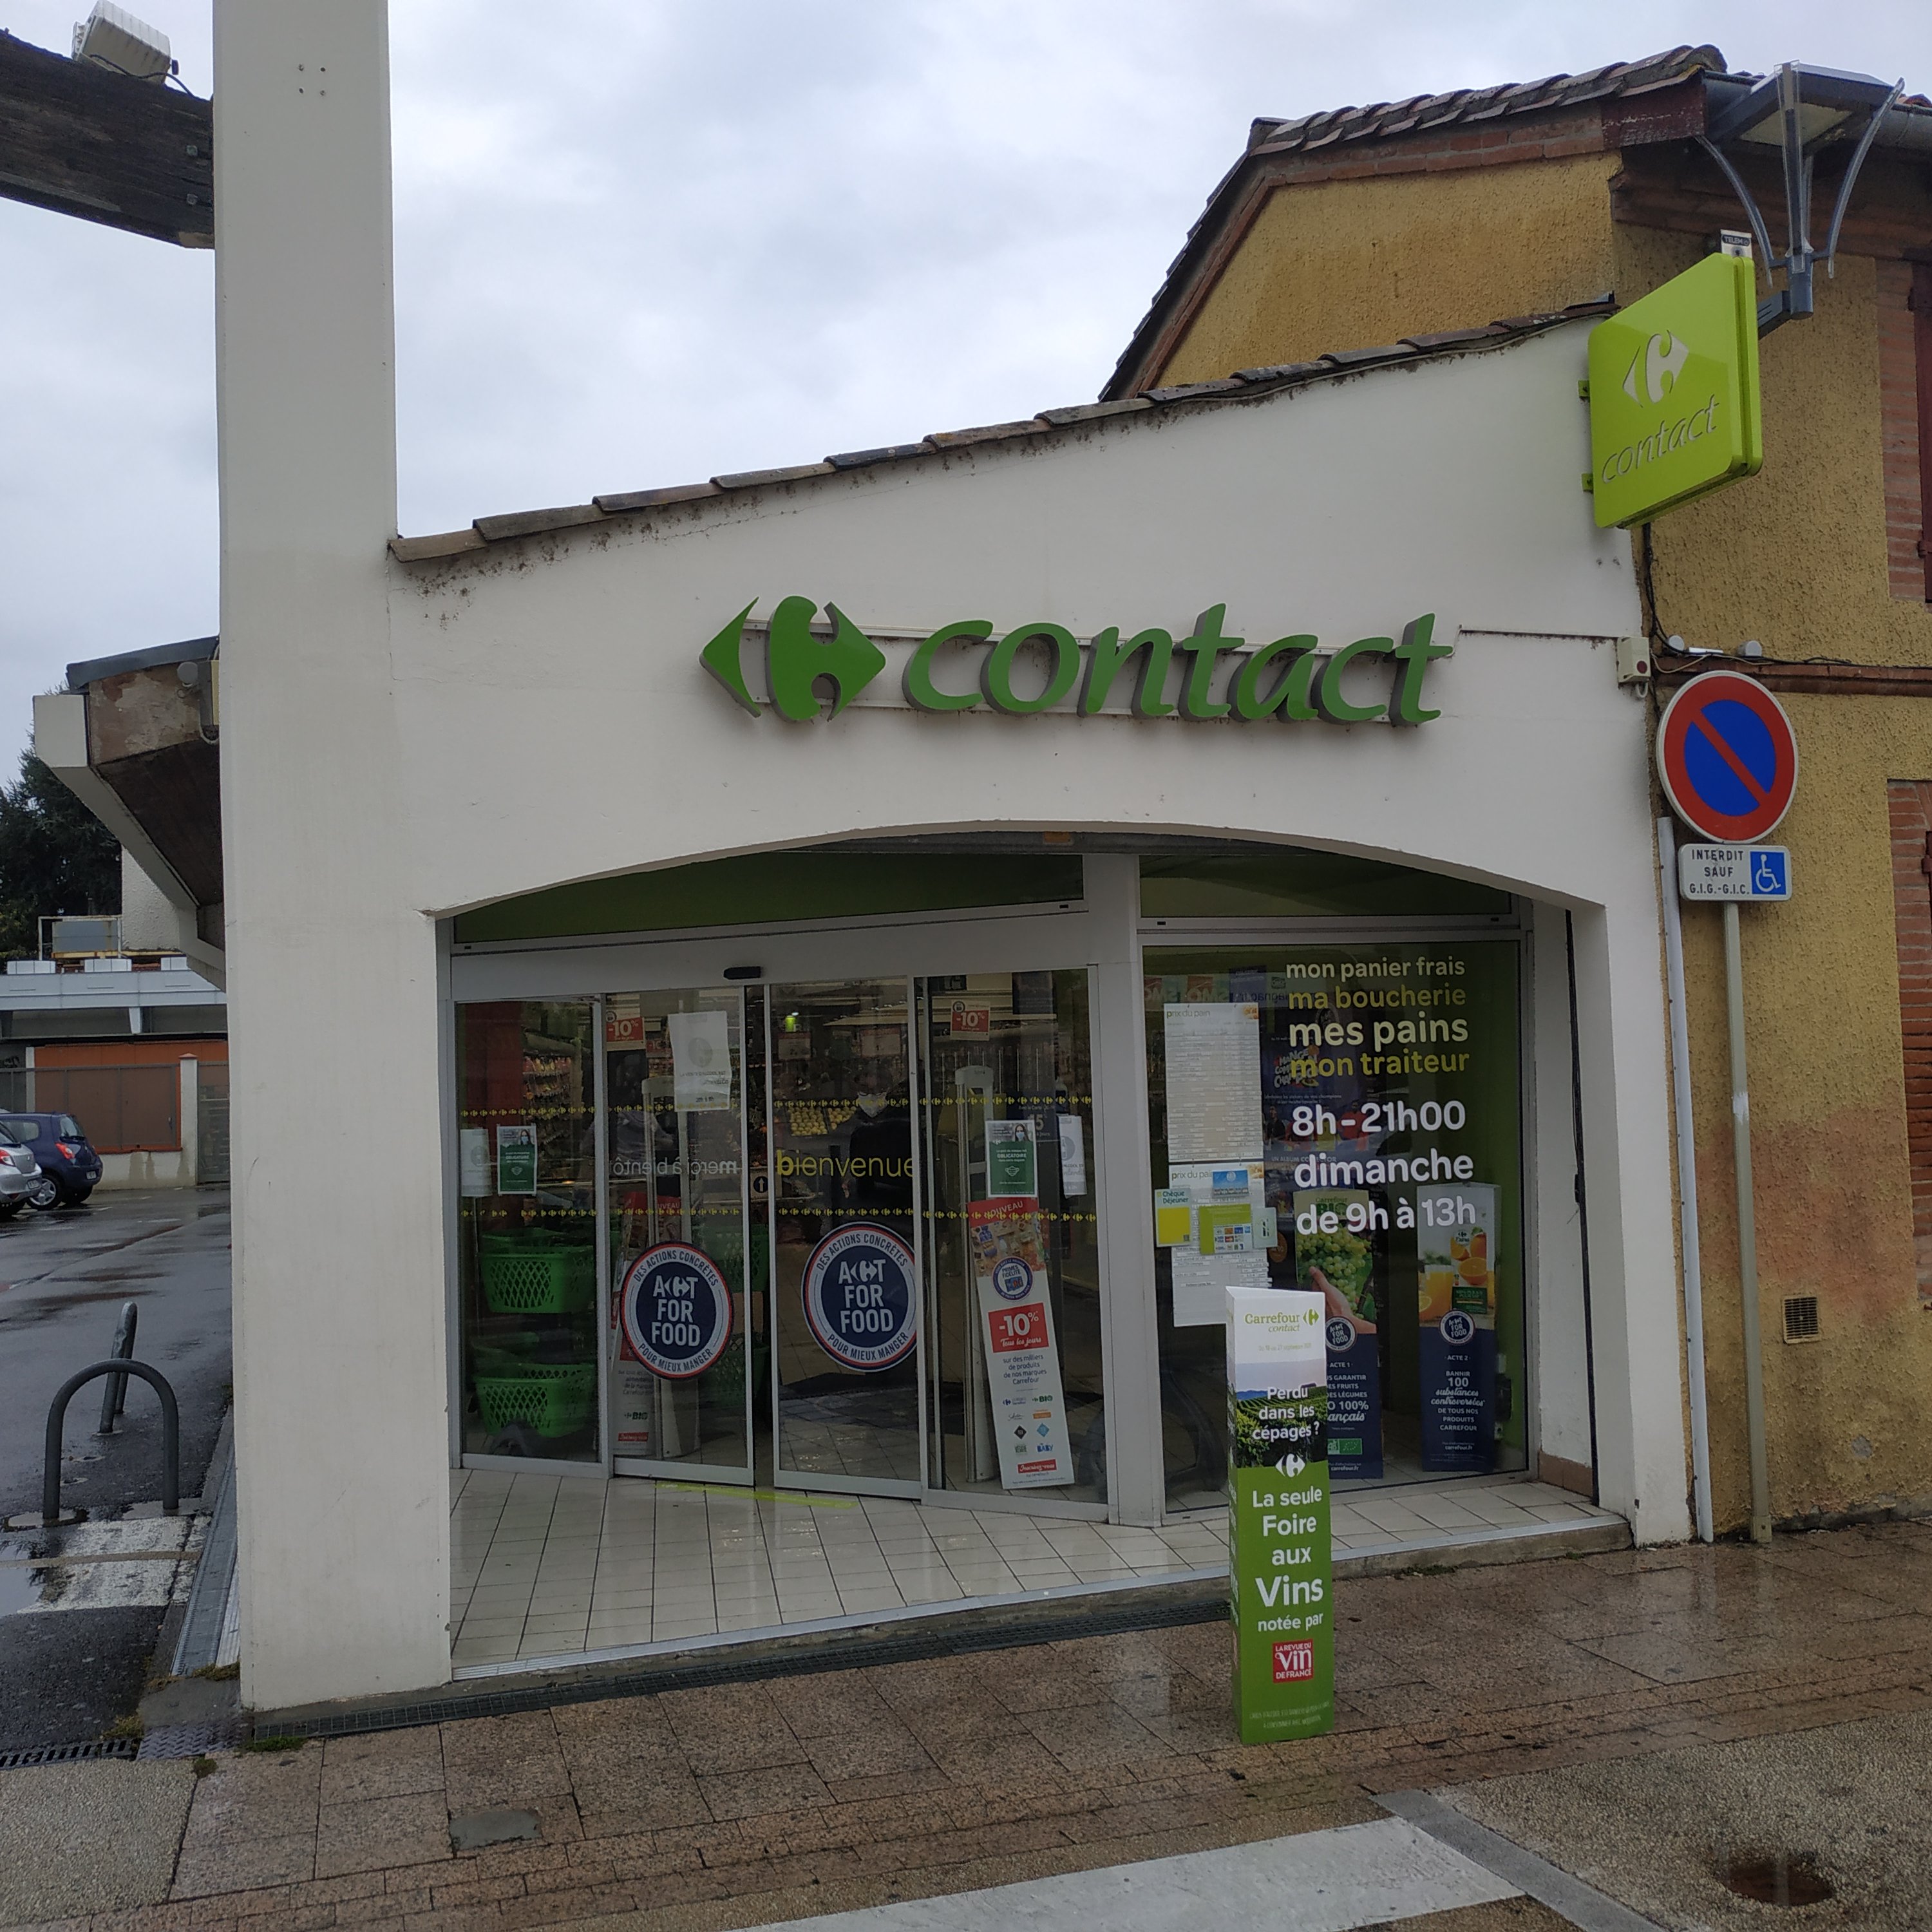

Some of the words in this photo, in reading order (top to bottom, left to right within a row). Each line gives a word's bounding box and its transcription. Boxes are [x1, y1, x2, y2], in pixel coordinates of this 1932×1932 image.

[1602, 393, 1720, 484] contact
[903, 603, 1453, 723] contact
[1692, 849, 1743, 860] INTERDIT
[1704, 867, 1733, 877] SAUF
[1286, 962, 1335, 979] mon
[1341, 957, 1411, 982] panier
[1416, 956, 1465, 976] frais
[1289, 992, 1329, 1010] ma
[1335, 983, 1466, 1009] boucherie
[1289, 1022, 1363, 1047] mes
[1374, 1012, 1469, 1052] pains
[1291, 1057, 1354, 1077] mon
[1360, 1049, 1470, 1076] traiteur
[776, 1148, 913, 1177] bienvenue
[1294, 1148, 1473, 1188] dimanche
[1171, 1171, 1186, 1181] prix
[1187, 1170, 1198, 1179] du
[1199, 1171, 1212, 1181] pai
[1162, 1197, 1189, 1205] Déjeuner
[1297, 1204, 1339, 1235] de
[1345, 1200, 1388, 1231] 9h
[1396, 1197, 1415, 1228] à
[1422, 1196, 1476, 1227] 13h
[817, 1253, 830, 1271] DES
[830, 1233, 861, 1256] ACTIONS
[864, 1233, 908, 1267] CONCRÈTES
[633, 1265, 647, 1282] DES
[647, 1250, 677, 1267] ACTIONS
[679, 1251, 719, 1287] CONCRÈTES
[844, 1284, 885, 1309] FOR
[657, 1299, 694, 1323] FOR
[839, 1309, 894, 1334] FOOD
[1244, 1312, 1300, 1325] Carrefour
[651, 1321, 701, 1347] FOOD
[999, 1310, 1039, 1337] -10%
[1268, 1324, 1300, 1333] contact
[1332, 1329, 1345, 1338] FOR
[1451, 1329, 1467, 1338] FOOD
[828, 1334, 848, 1358] POUR
[850, 1349, 876, 1361] MIEUX
[877, 1332, 909, 1359] MANGER
[1332, 1335, 1349, 1345] FOOD
[638, 1343, 658, 1364] POUR
[658, 1359, 682, 1372] MIEUX
[683, 1349, 714, 1371] MANGER
[1267, 1386, 1308, 1400] Perdu
[1435, 1387, 1479, 1397] substances
[1448, 1377, 1469, 1387] 100
[1258, 1406, 1295, 1420] dans
[1299, 1405, 1315, 1417] les
[1338, 1400, 1369, 1410] 100%
[1253, 1490, 1274, 1508] La
[1280, 1485, 1323, 1506] seule
[1263, 1513, 1317, 1537] Foire
[1271, 1546, 1311, 1566] aux
[1255, 1575, 1323, 1607] Vins
[1258, 1615, 1302, 1632] notée
[1305, 1613, 1324, 1631] par
[1284, 1643, 1303, 1651] REVUE
[1286, 1669, 1312, 1678] FRANCE
